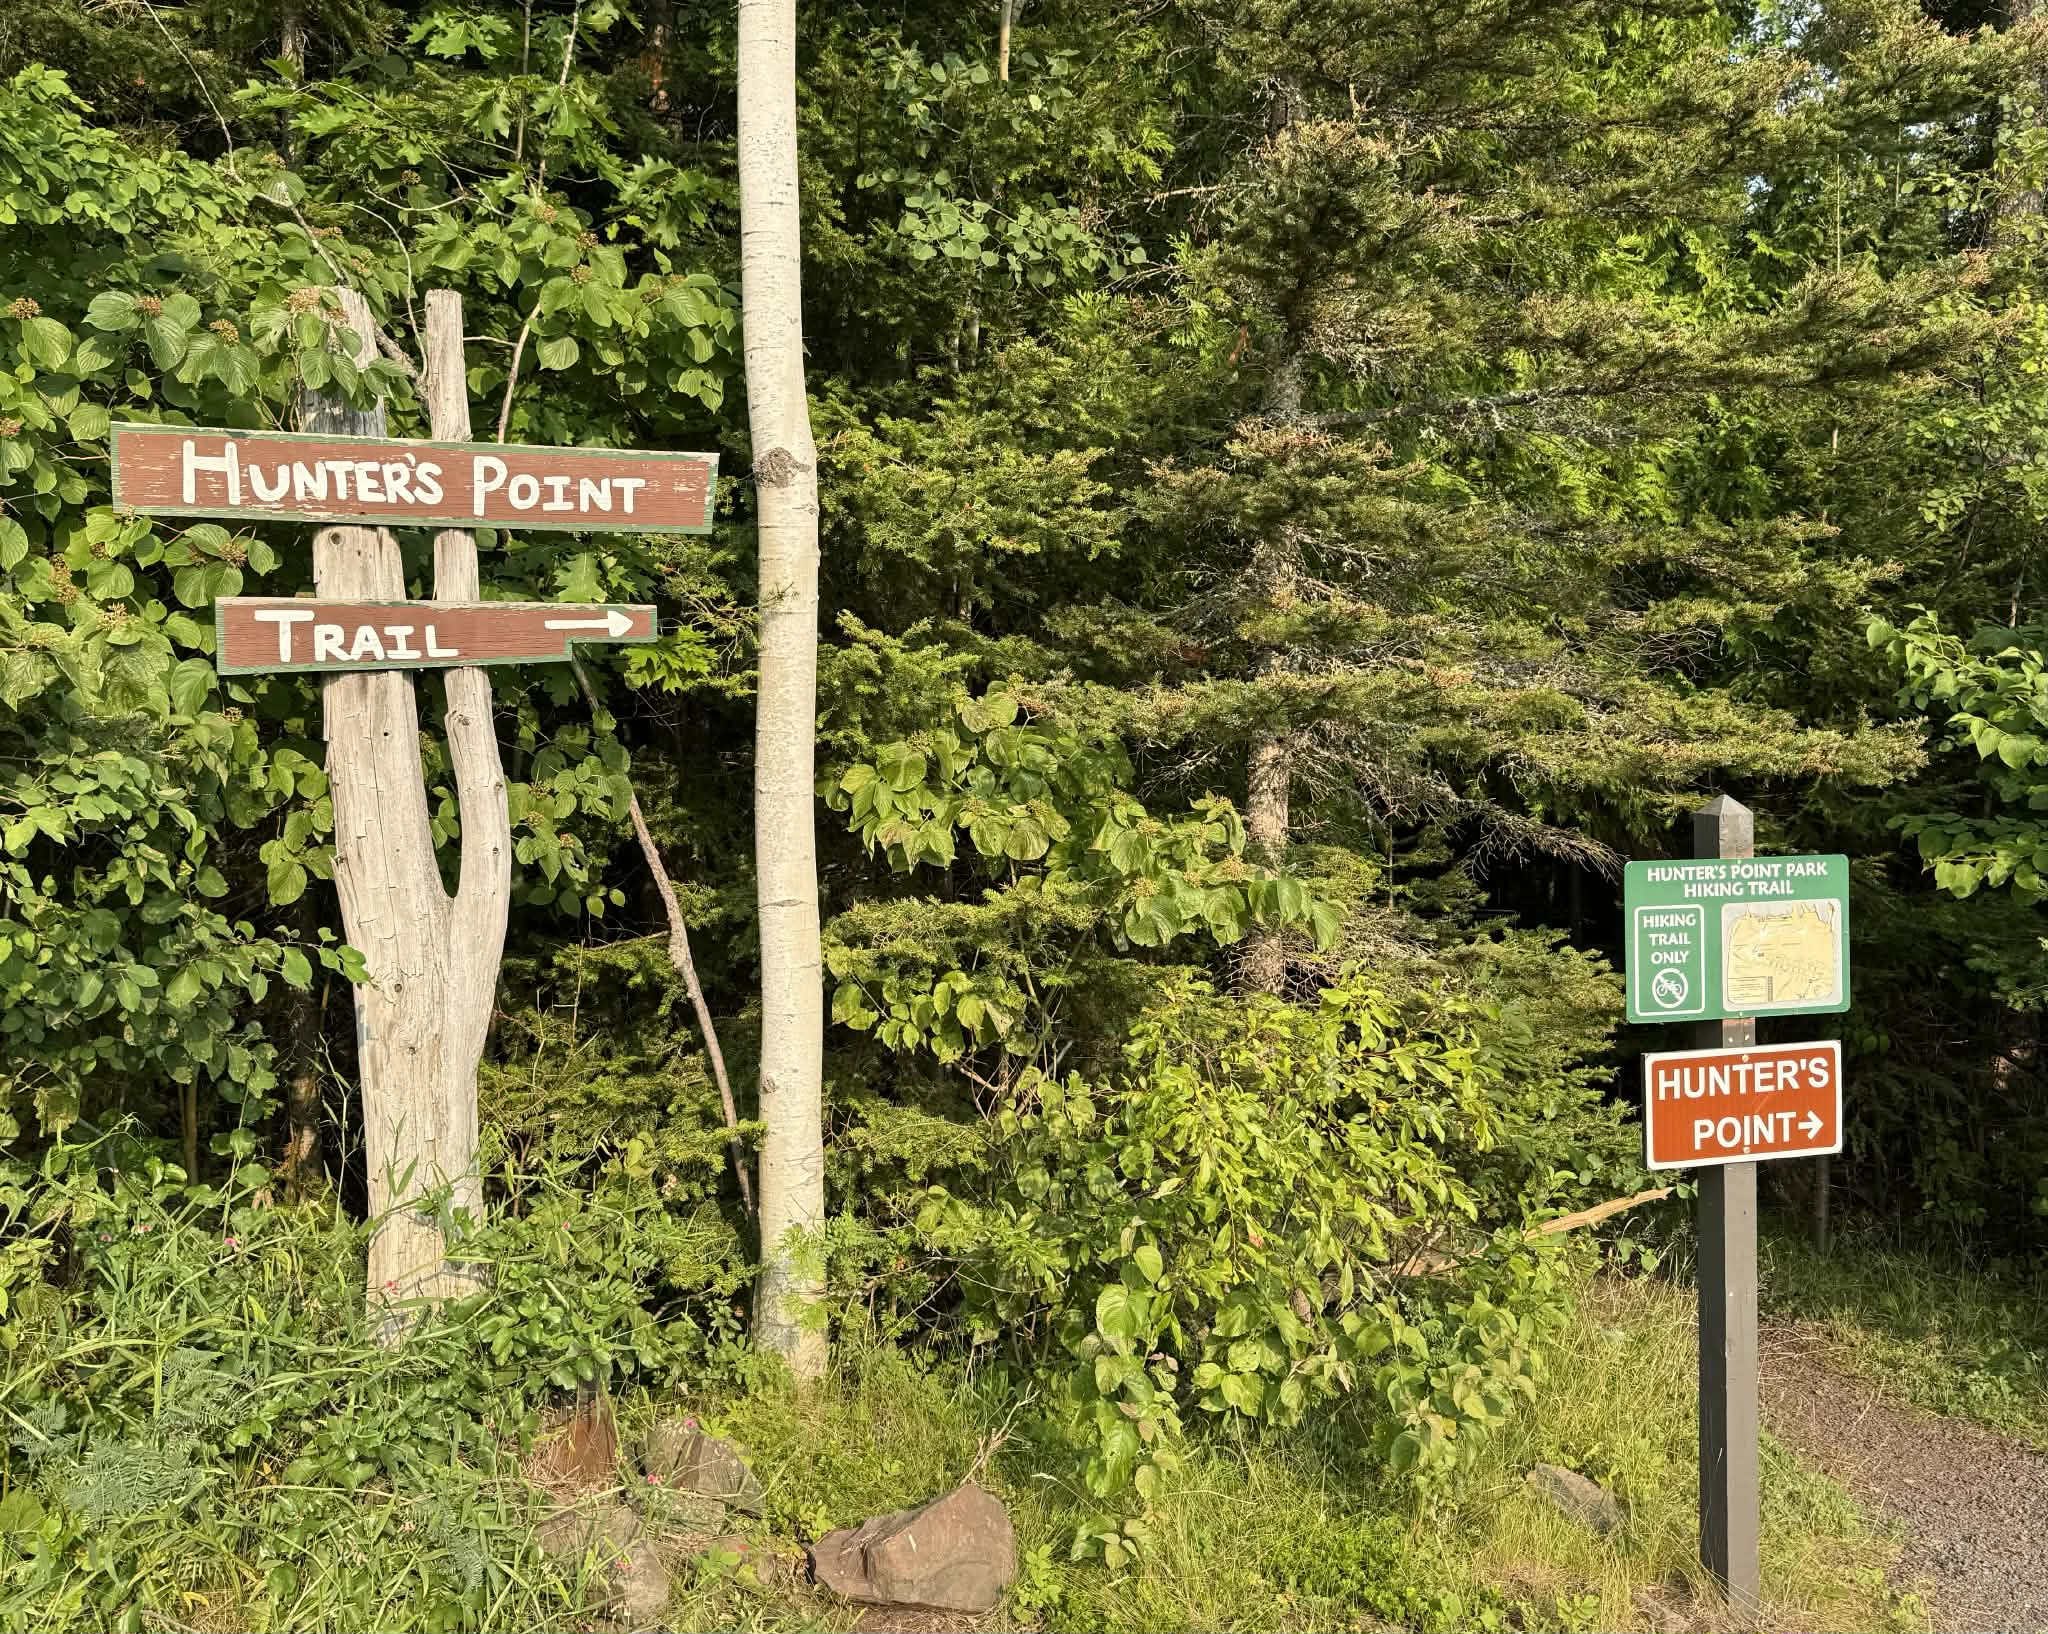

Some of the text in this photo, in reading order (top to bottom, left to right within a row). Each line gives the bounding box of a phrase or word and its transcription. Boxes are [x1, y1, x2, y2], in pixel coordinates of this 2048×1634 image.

[182, 440, 645, 516] HUNTER'S POINT
[254, 610, 459, 663] TRAIL
[1647, 862, 1828, 881] HUNTER'S POINT PARK
[1684, 880, 1794, 898] HIKING TRAIL
[1643, 914, 1696, 929] HIKING
[1648, 933, 1691, 946] TRAIL
[1651, 951, 1689, 964] ONLY
[1658, 1057, 1829, 1101] HUNTER'S
[1694, 1111, 1797, 1150] POINT
